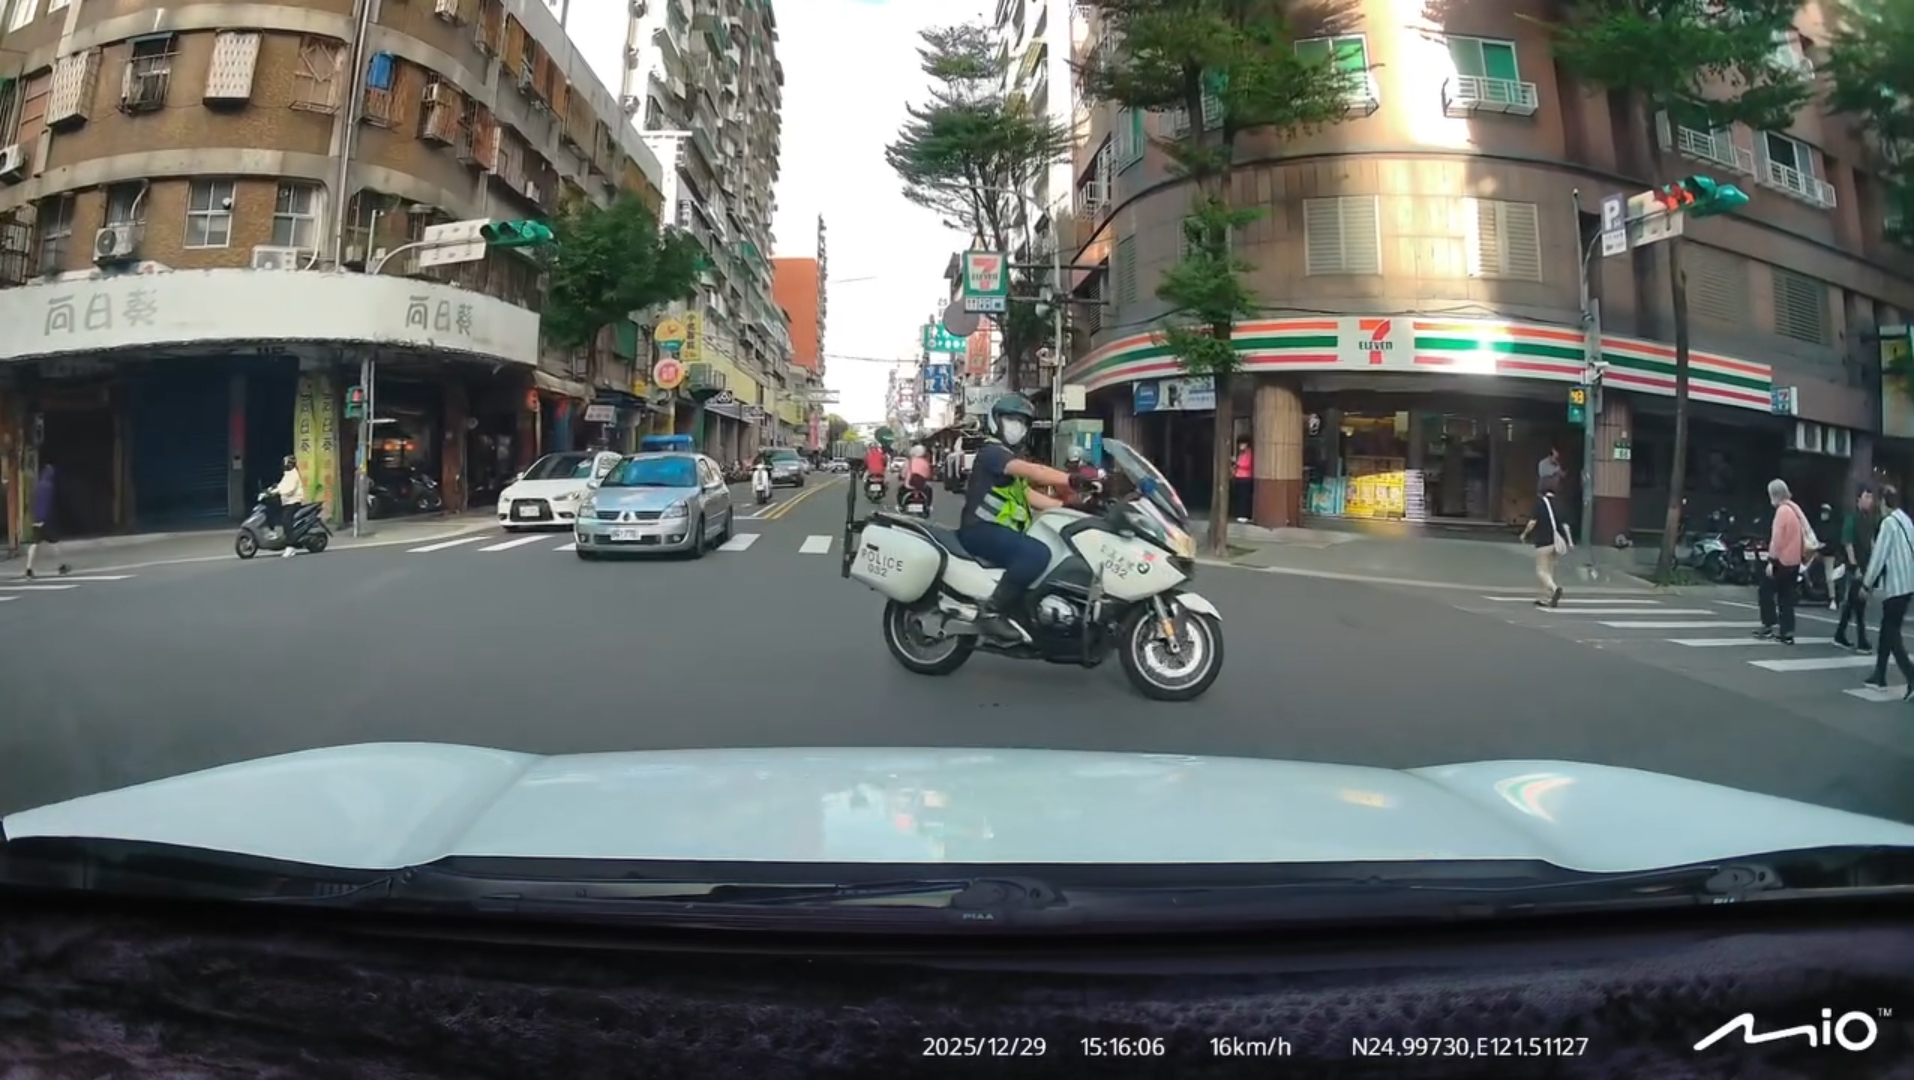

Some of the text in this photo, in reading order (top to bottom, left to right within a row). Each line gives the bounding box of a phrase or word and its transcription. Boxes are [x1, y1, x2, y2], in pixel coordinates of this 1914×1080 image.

[1604, 199, 1620, 231] P
[972, 257, 998, 290] 7
[1359, 319, 1391, 365] 7
[861, 548, 904, 573] POLICE
[868, 563, 888, 578] 032
[1105, 559, 1128, 580] 032
